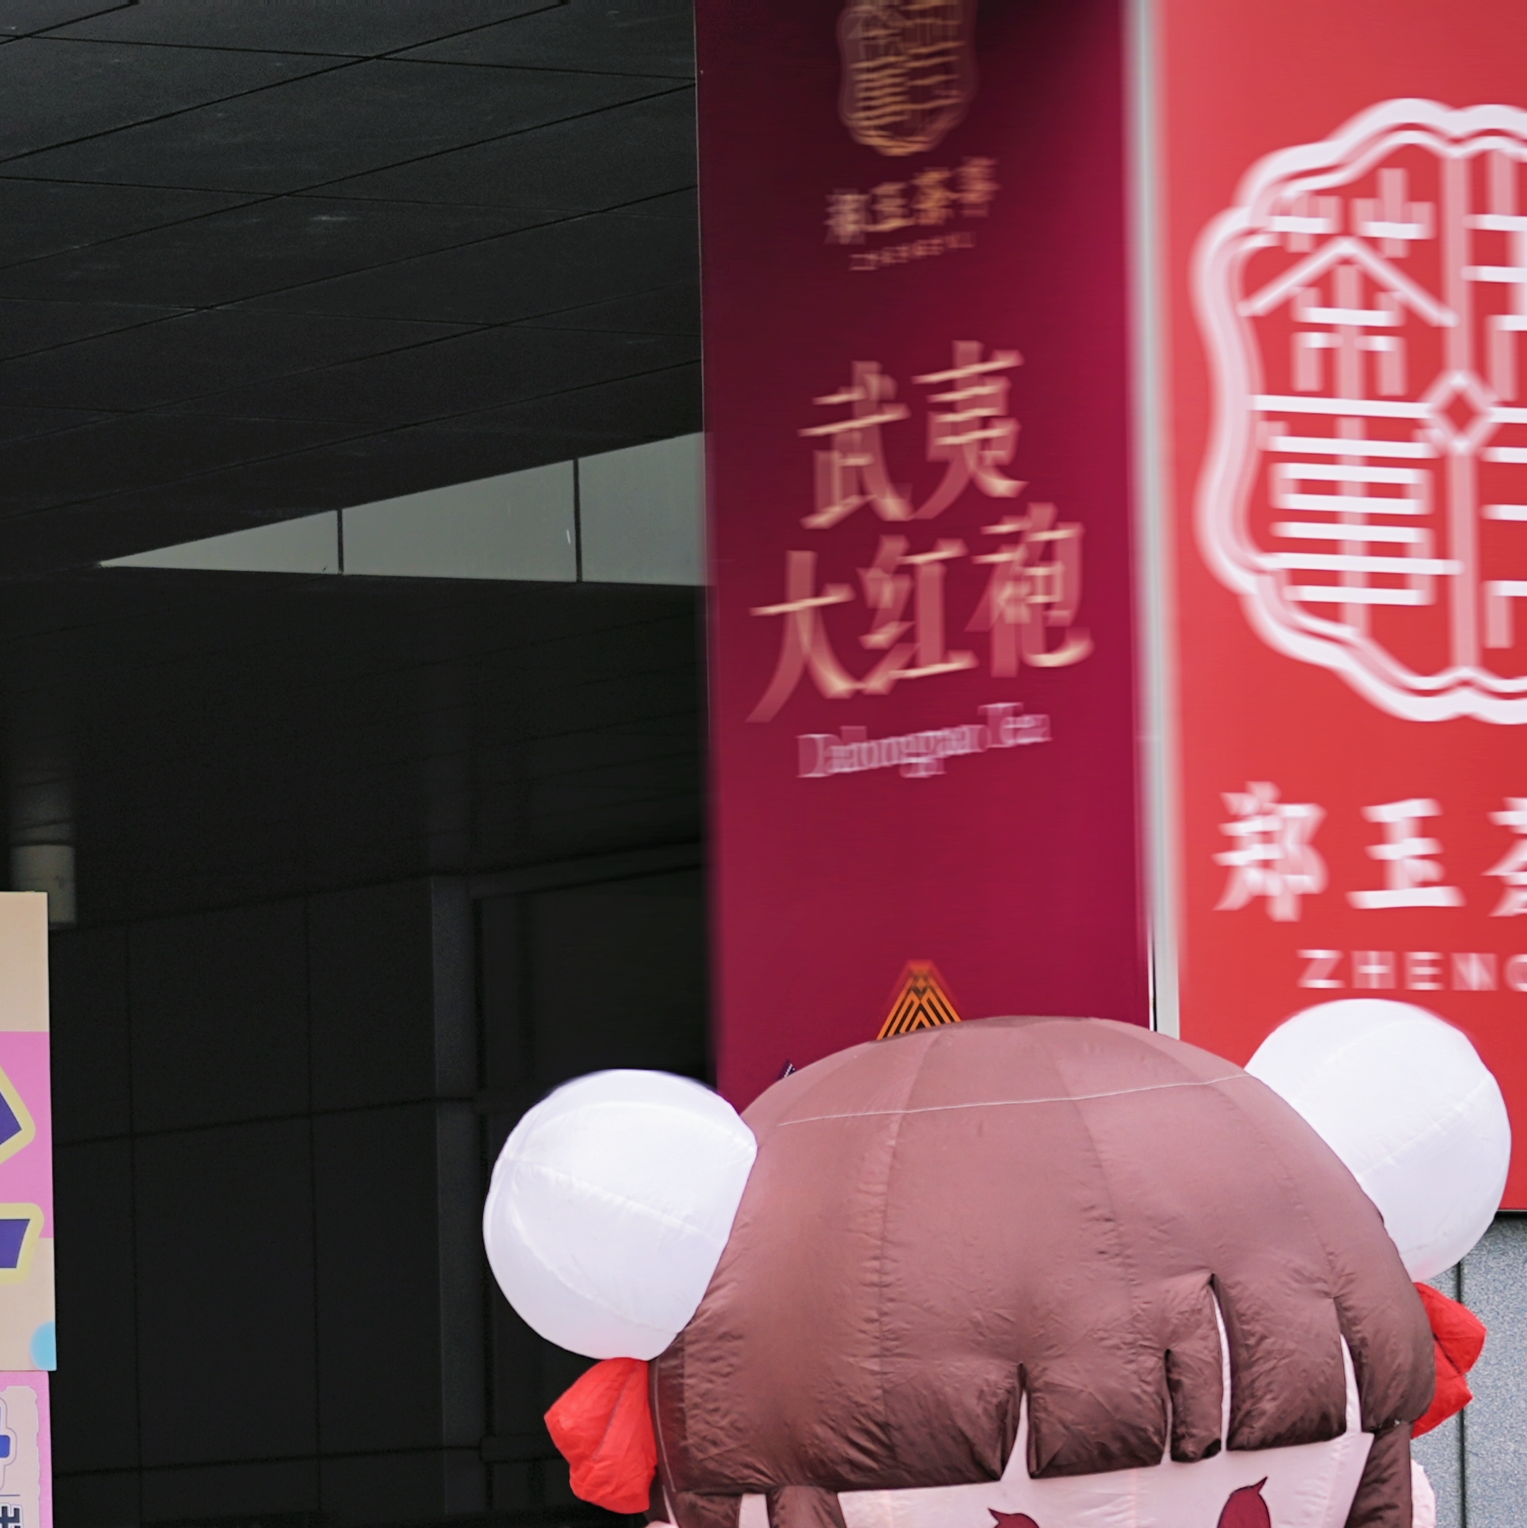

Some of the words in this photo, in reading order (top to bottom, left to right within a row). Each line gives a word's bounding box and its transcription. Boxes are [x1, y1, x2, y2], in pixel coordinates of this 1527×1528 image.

[798, 340, 1029, 529] 武夷
[746, 502, 1094, 722] 大红袍
